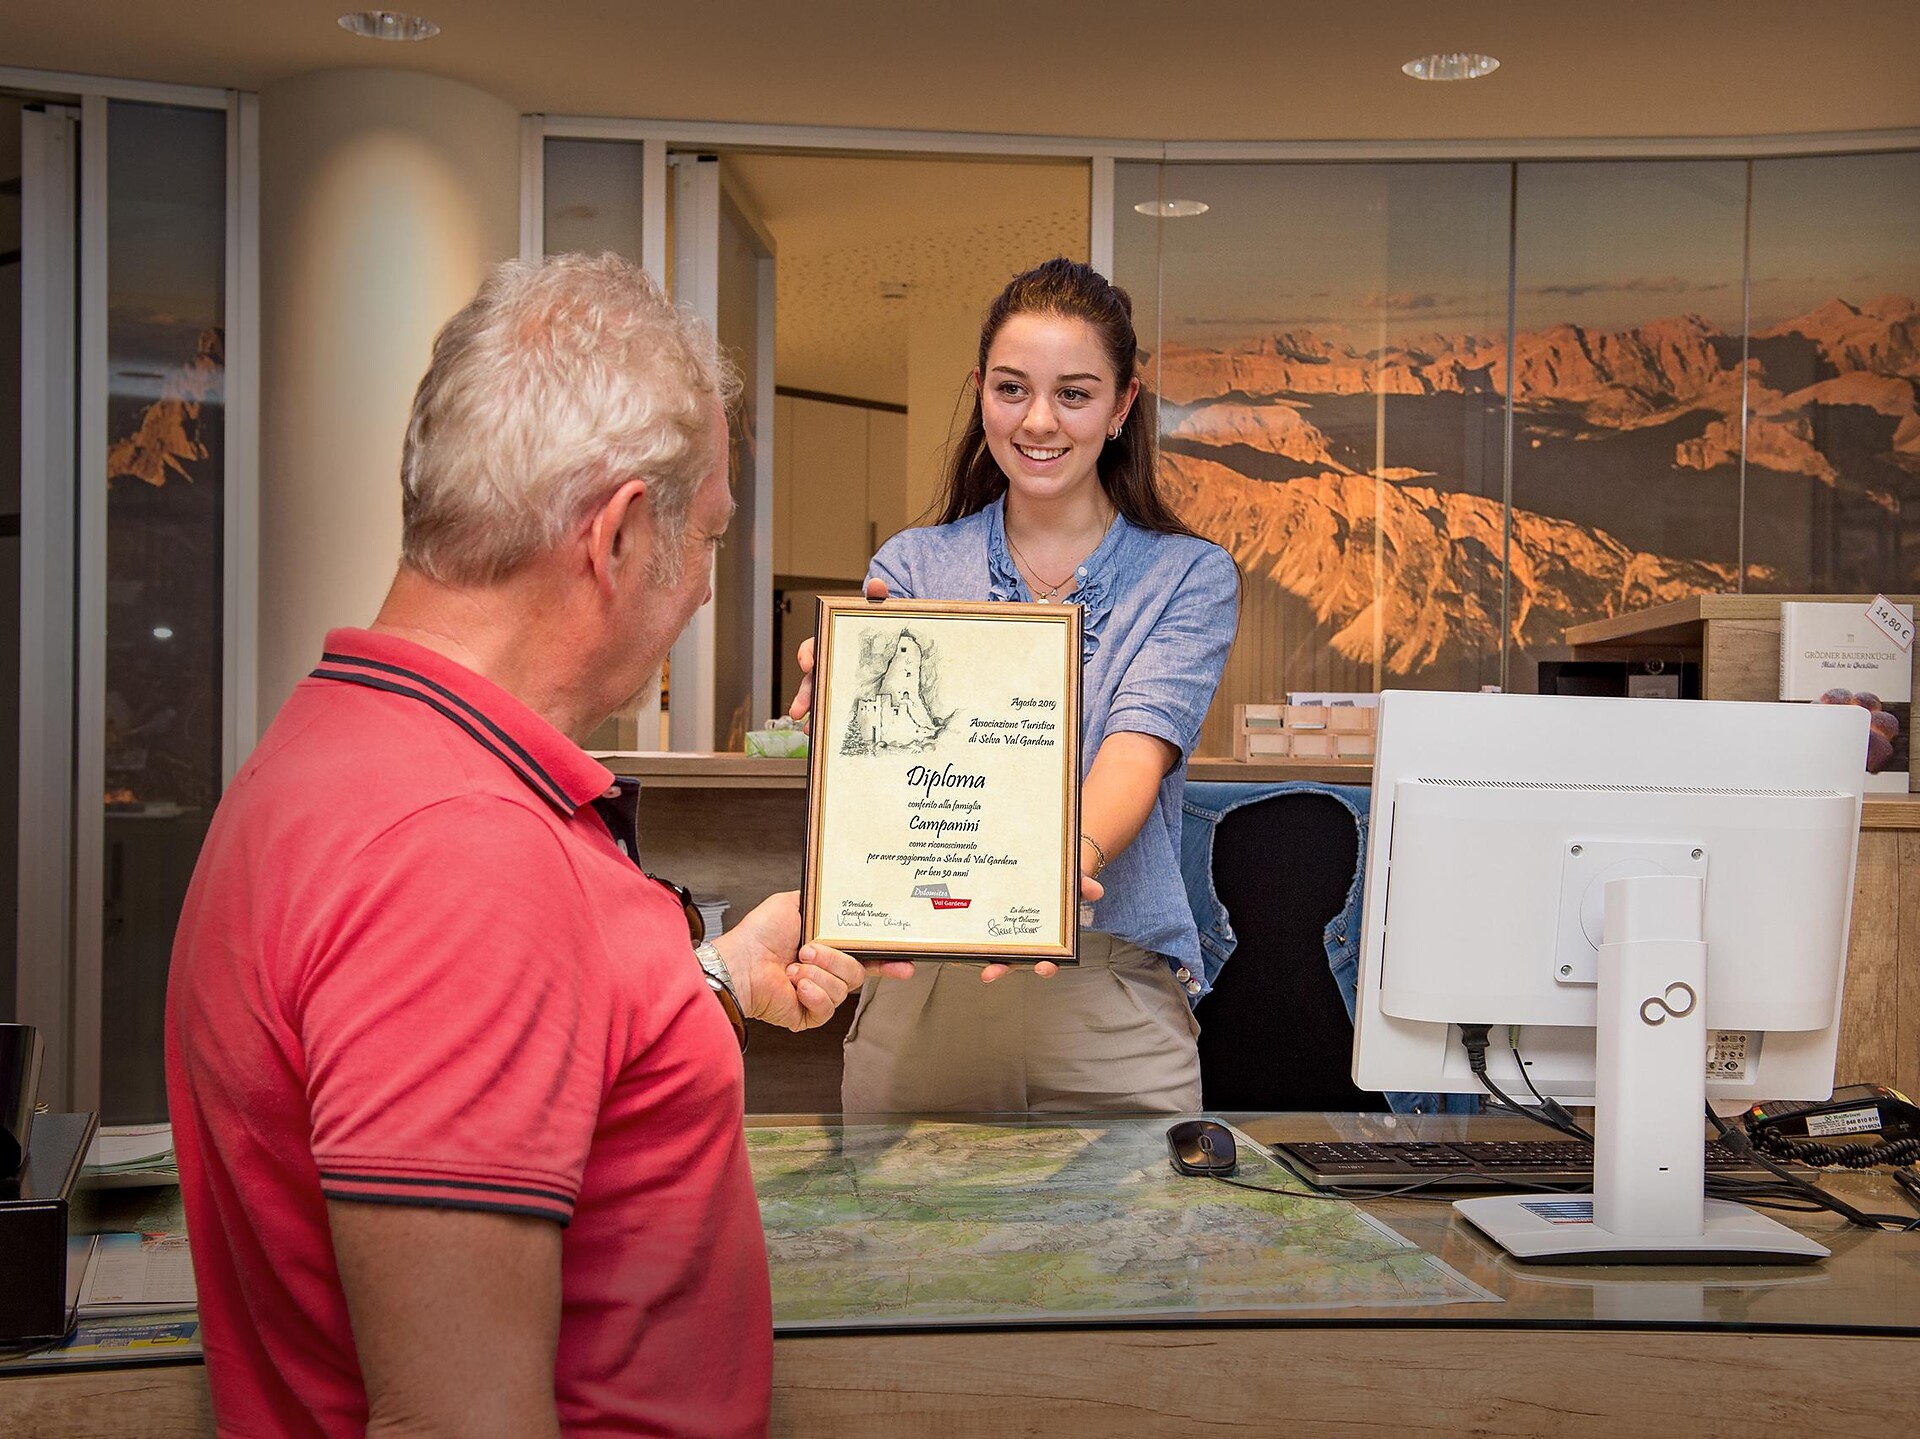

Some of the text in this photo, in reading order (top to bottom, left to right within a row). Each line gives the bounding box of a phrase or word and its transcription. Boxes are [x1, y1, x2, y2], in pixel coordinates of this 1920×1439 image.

[1875, 606, 1911, 640] 14,80 €
[1804, 650, 1896, 661] GRÖDNER BAUERNKÜCHE
[1010, 697, 1057, 710] Agosto 2019
[969, 717, 1055, 730] Associazione Turistica
[968, 732, 1055, 747] di Selva Val Gardena
[906, 763, 986, 798] Diploma
[908, 799, 981, 814] conferito alla famiglia
[909, 815, 980, 838] Campanini
[909, 840, 977, 850] come riconoscimento
[866, 853, 880, 864] per
[896, 854, 935, 866] soggiornato
[943, 854, 963, 864] Selva
[964, 854, 971, 864] di
[973, 855, 987, 865] Val
[987, 855, 1017, 866] Gardena
[914, 867, 969, 879] per ben 30 anni
[913, 887, 948, 897] Dolomites
[841, 909, 866, 919] Christoph
